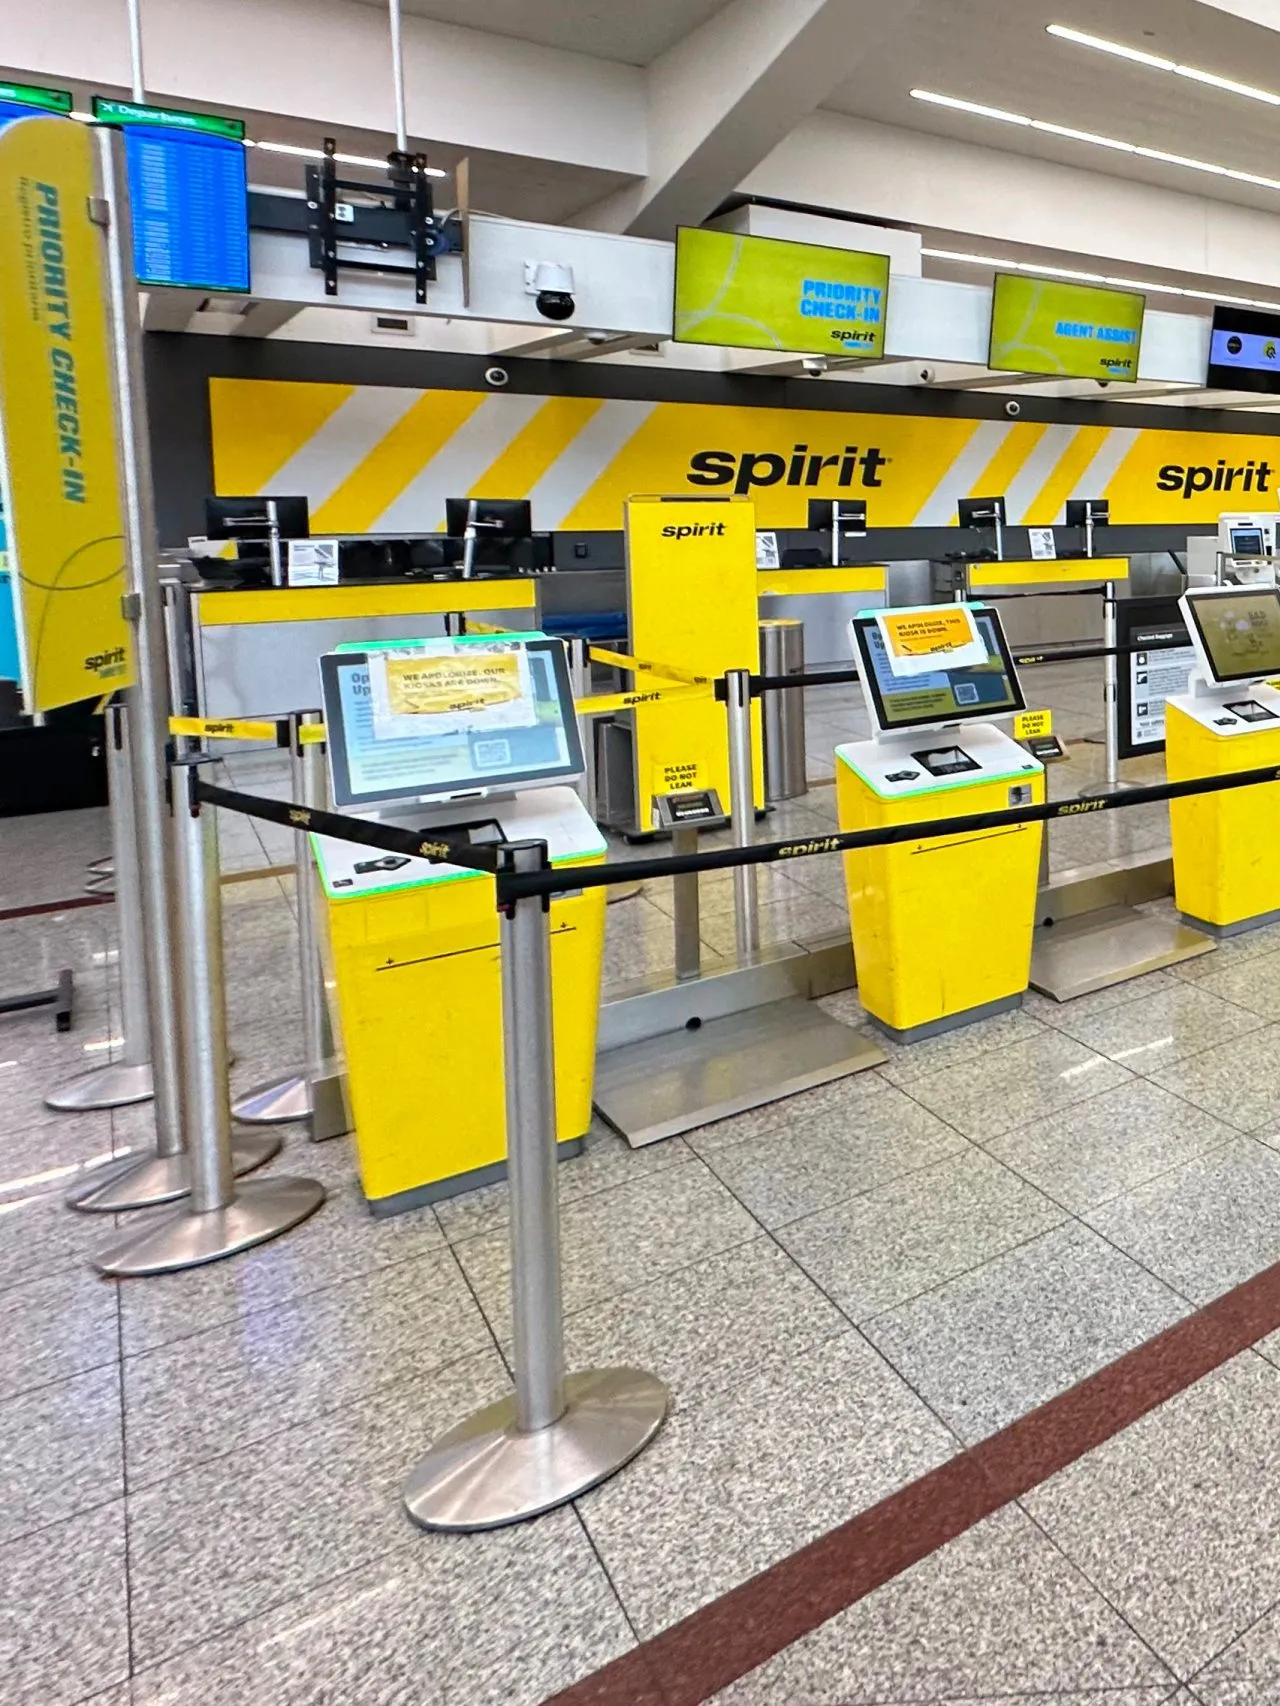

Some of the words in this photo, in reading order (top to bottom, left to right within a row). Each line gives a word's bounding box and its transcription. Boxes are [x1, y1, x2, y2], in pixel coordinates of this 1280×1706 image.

[36, 181, 72, 341] PRIORITY
[803, 279, 882, 305] PRIORITY
[800, 298, 880, 323] CHECK-IN
[831, 330, 876, 342] spirit
[1055, 321, 1094, 338] AGENT
[1096, 326, 1137, 344] ASSIST
[1100, 358, 1132, 368] spirit
[51, 347, 86, 503] CHECK-IN
[686, 444, 887, 496] spirit
[1156, 459, 1271, 499] spirit
[662, 523, 726, 540] spirit
[84, 646, 125, 672] spirit
[403, 673, 419, 681] WE
[623, 691, 661, 705] spirit
[204, 716, 235, 734] spirit
[664, 764, 697, 773] PLEASE
[680, 772, 697, 780] NOT
[1057, 798, 1106, 816] spirit
[778, 837, 842, 857] spirit
